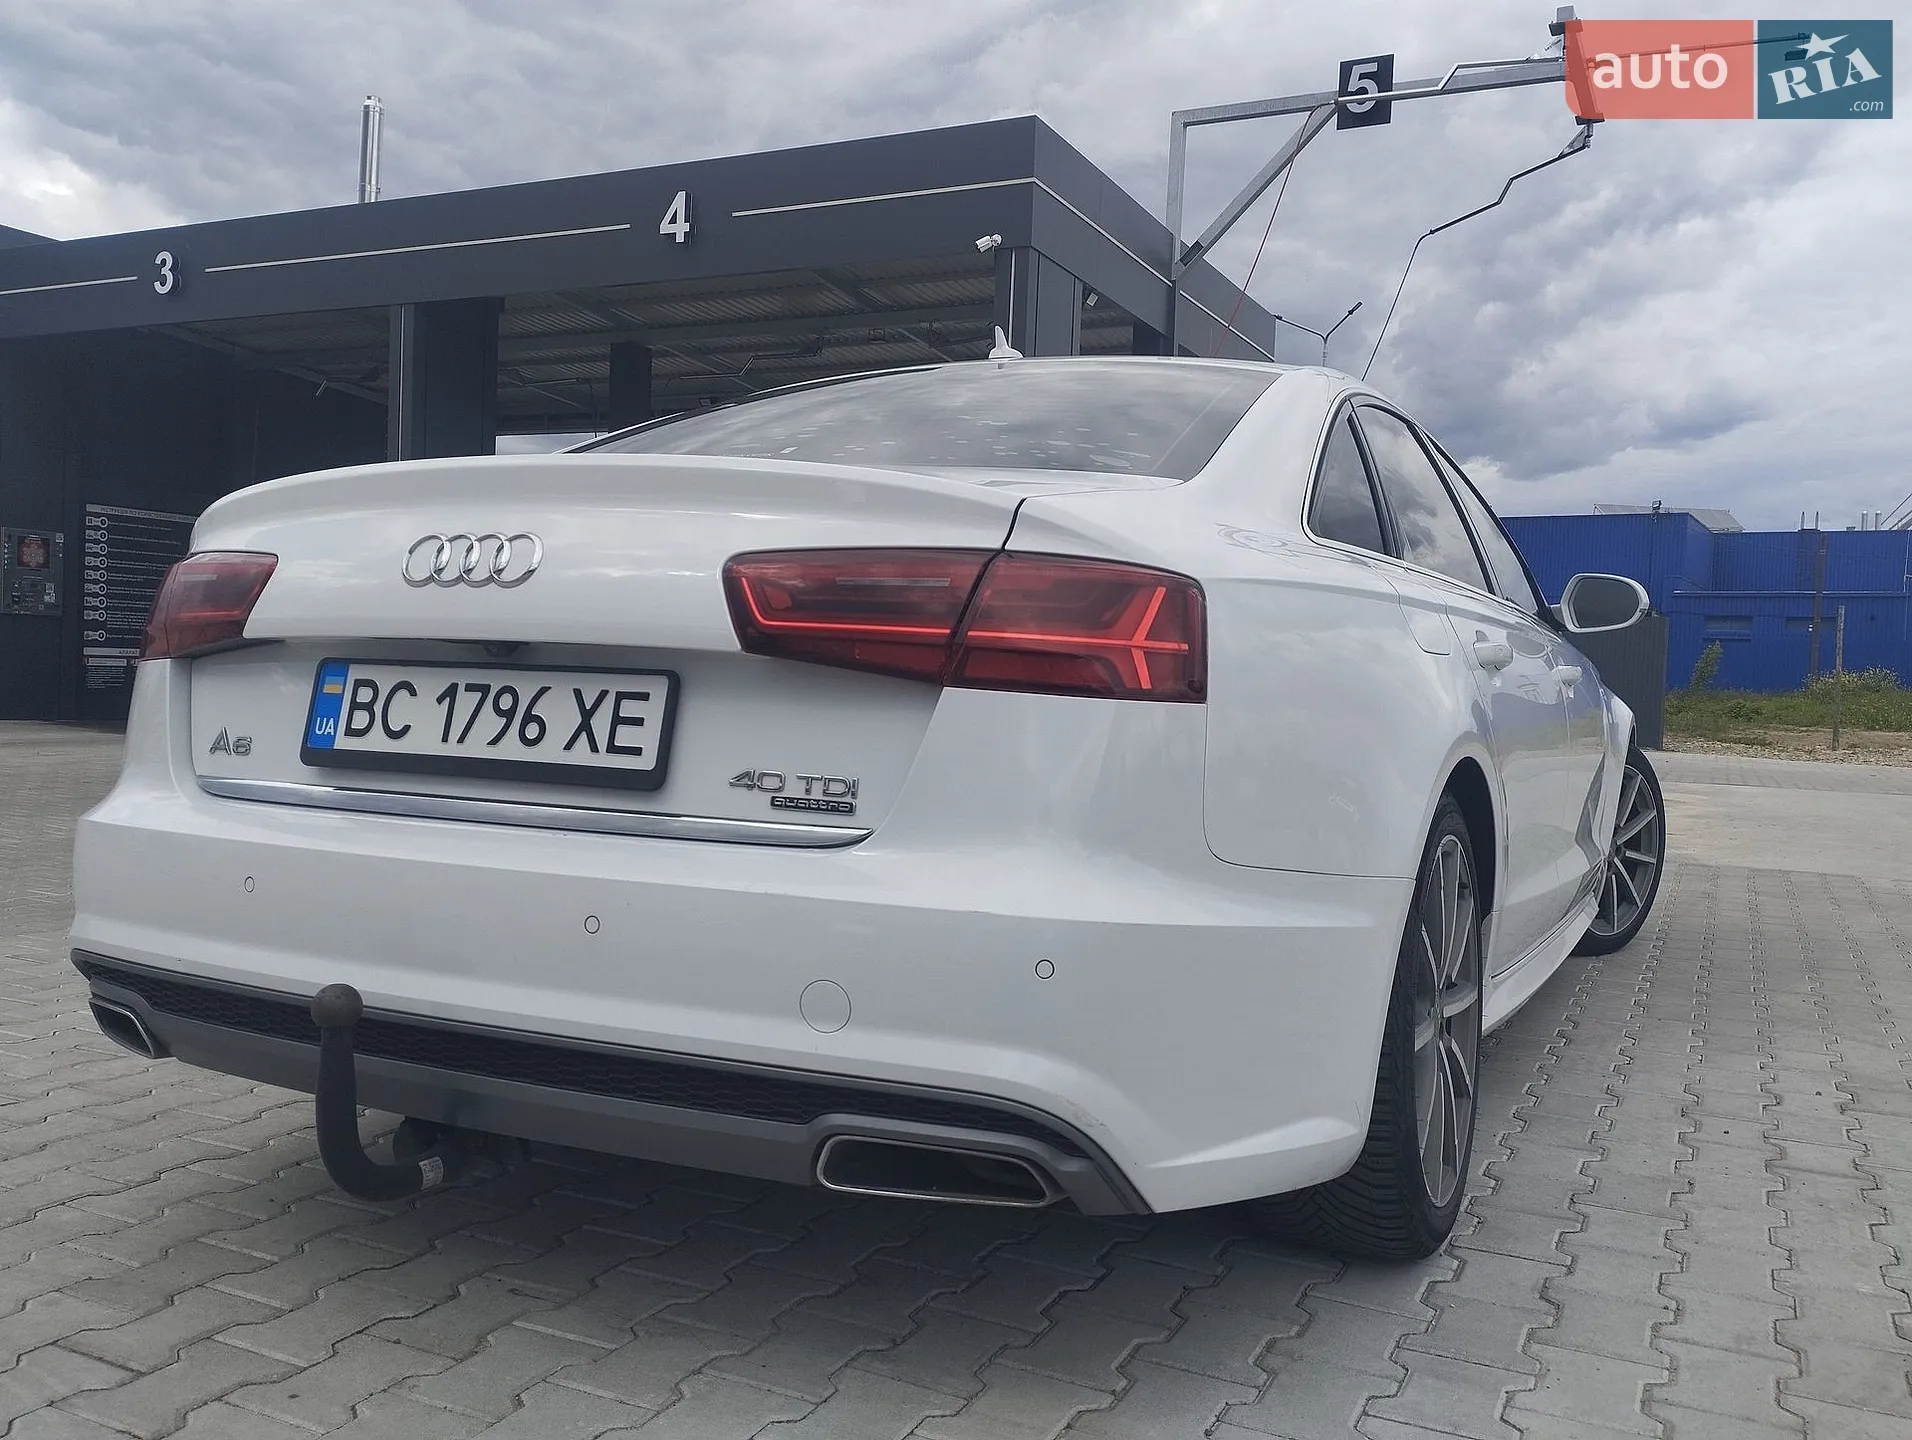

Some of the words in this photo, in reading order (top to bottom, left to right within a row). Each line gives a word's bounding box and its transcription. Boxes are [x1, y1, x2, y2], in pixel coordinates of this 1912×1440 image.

[1346, 62, 1378, 113] 5
[659, 190, 690, 243] 4
[153, 250, 174, 294] 3
[315, 716, 334, 735] UA
[343, 678, 418, 740] BC
[435, 682, 553, 748] 1796
[562, 687, 651, 757] XE
[209, 726, 252, 756] A6
[728, 769, 786, 793] 40
[796, 773, 860, 799] TDI
[773, 797, 851, 812] quattro
